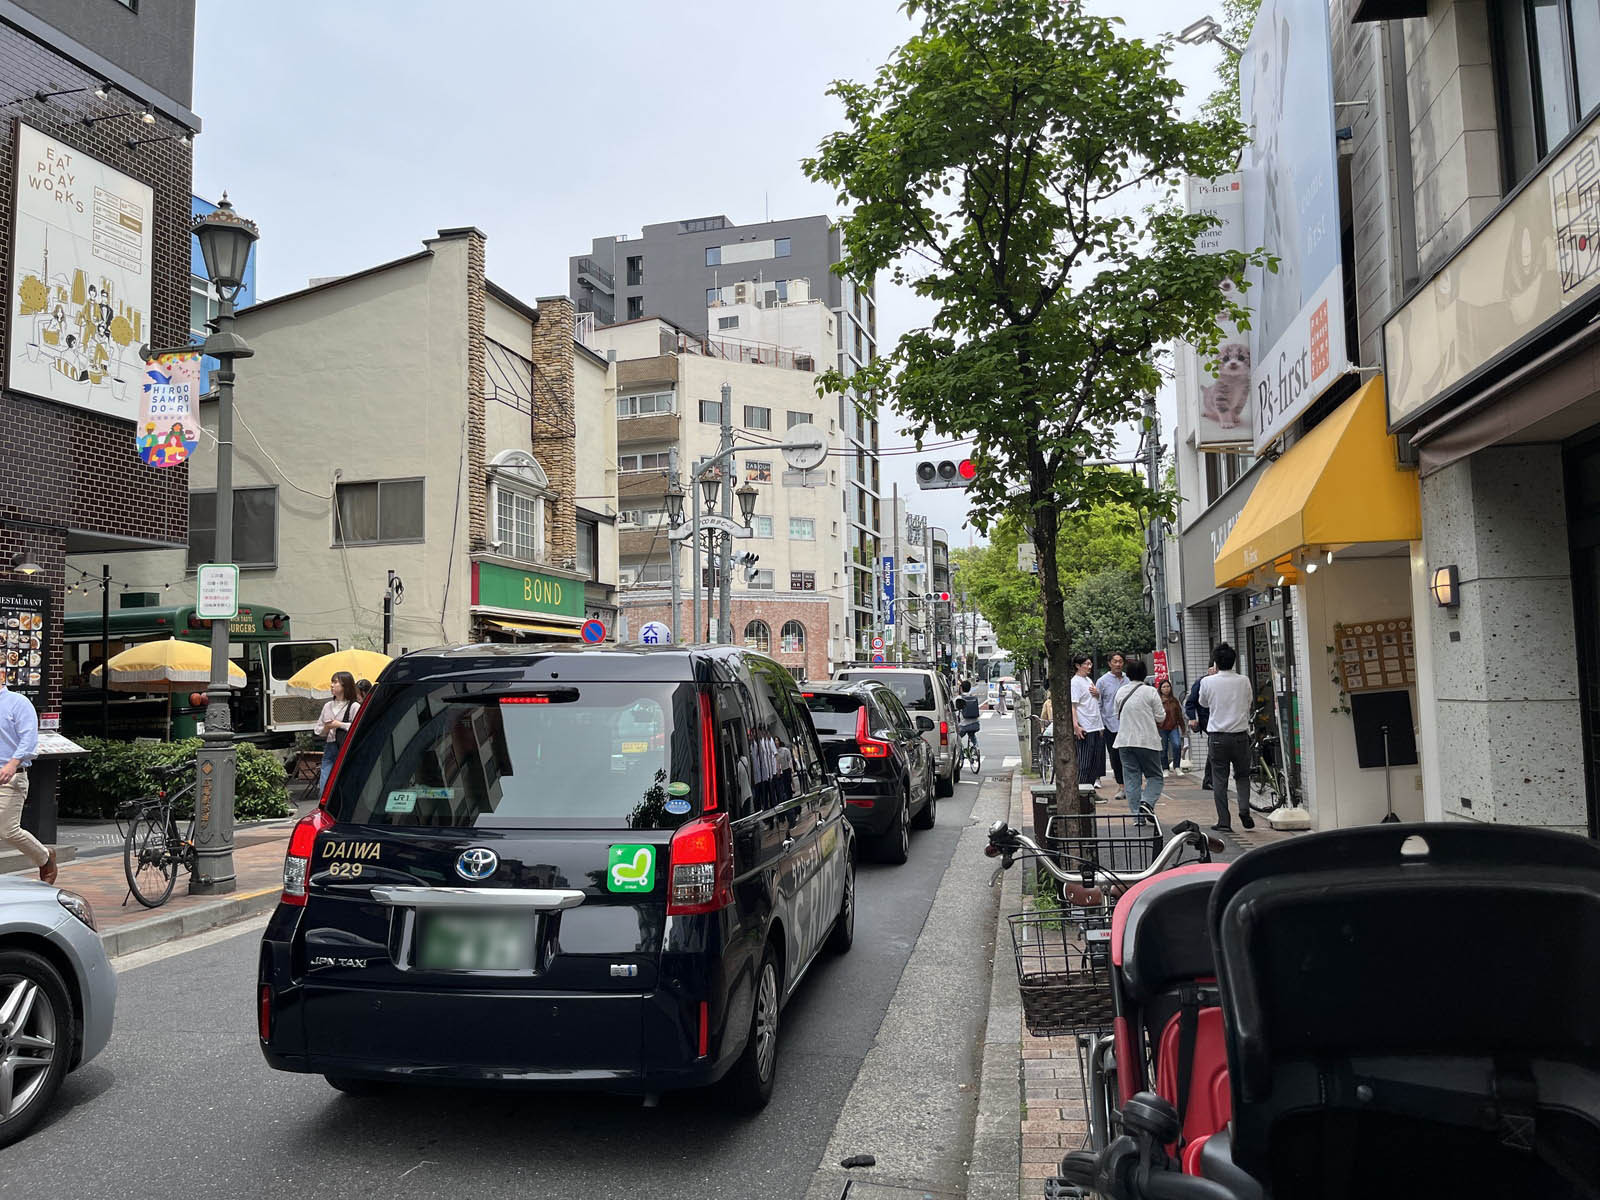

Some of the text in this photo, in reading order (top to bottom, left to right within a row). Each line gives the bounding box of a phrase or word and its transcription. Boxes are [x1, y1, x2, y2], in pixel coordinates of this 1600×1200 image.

[46, 147, 73, 170] EAT
[37, 161, 75, 188] PLAY
[28, 175, 84, 214] WORKS
[1201, 240, 1219, 249] first
[153, 384, 189, 395] HIROO
[1258, 346, 1309, 437] P's-first
[151, 394, 189, 404] SAMPO
[151, 404, 189, 413] DO-RI
[523, 577, 562, 606] BOND
[0, 596, 43, 607] ESTAURANT
[229, 623, 257, 633] URGERS
[321, 841, 381, 860] DAIWA
[329, 862, 363, 877] 629
[338, 958, 368, 968] TAXI
